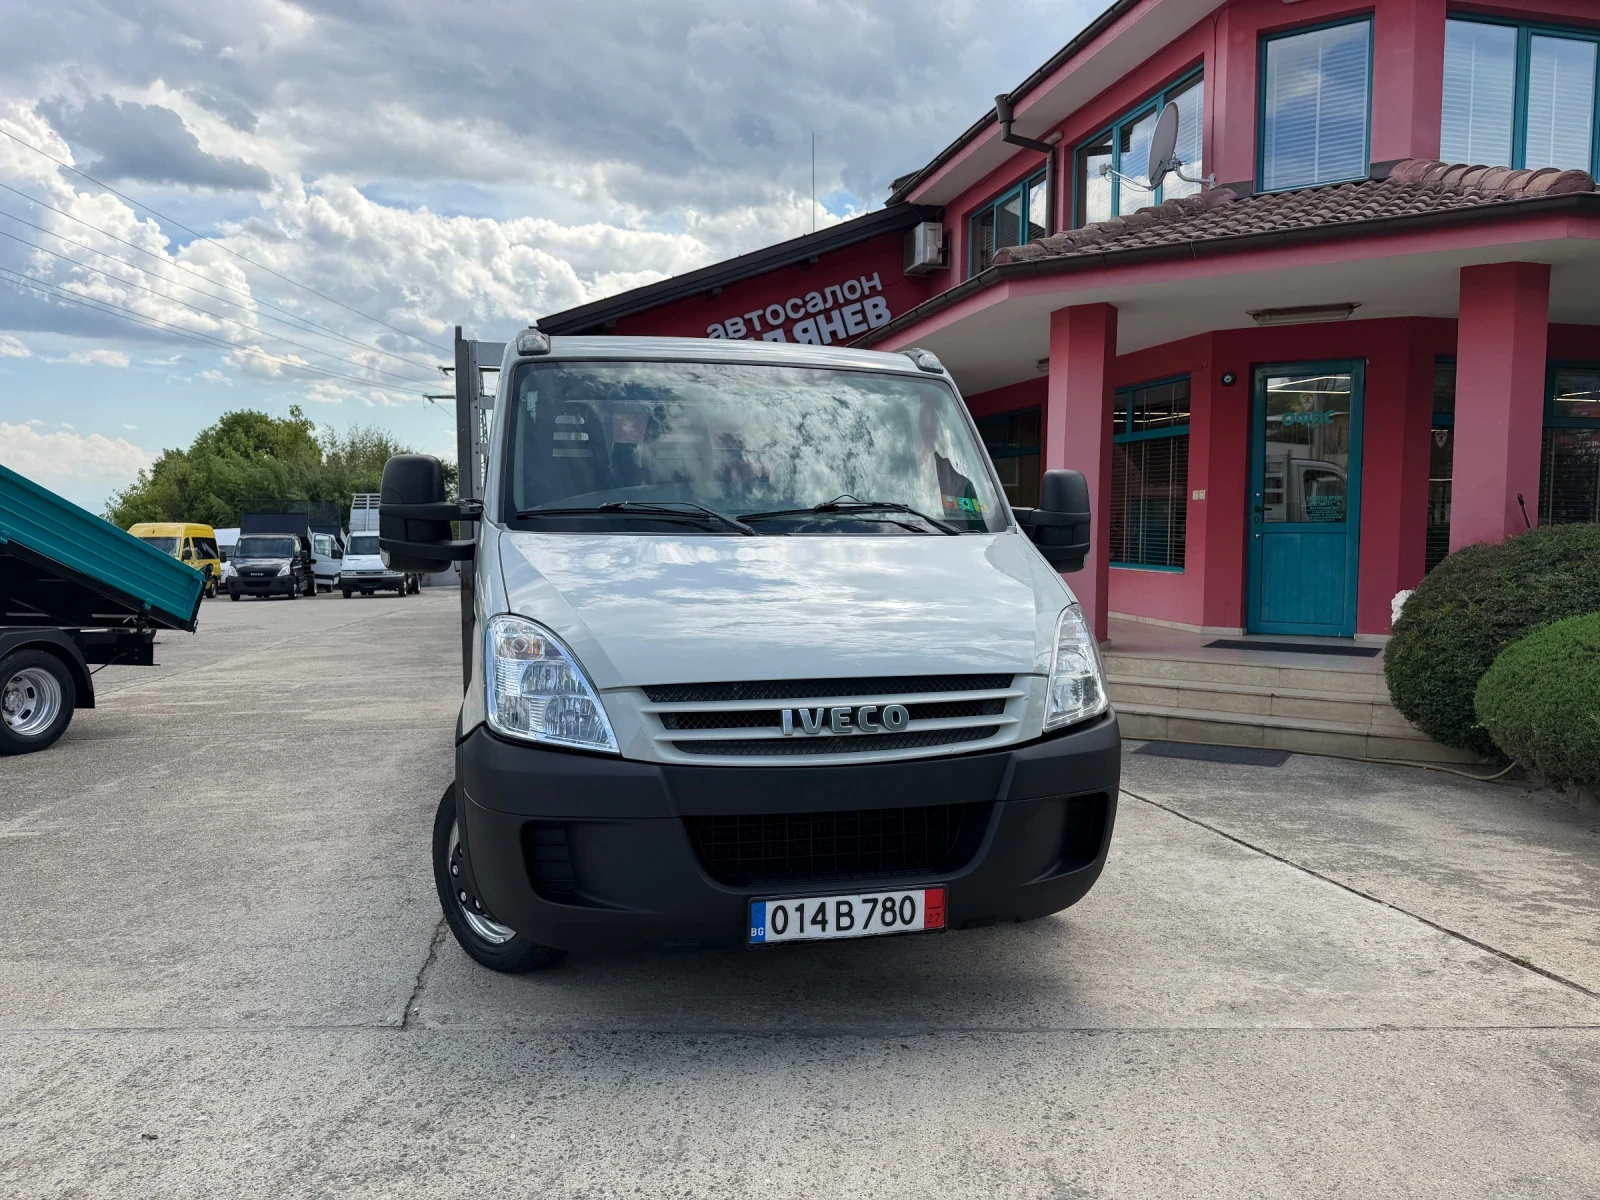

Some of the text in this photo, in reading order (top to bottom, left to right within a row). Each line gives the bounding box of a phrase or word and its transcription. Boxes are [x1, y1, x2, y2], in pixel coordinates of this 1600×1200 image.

[706, 271, 883, 340] автосалон
[792, 295, 892, 345] ЯНЕВ
[1282, 409, 1335, 427] ОФИС
[781, 704, 910, 736] IVECO
[750, 926, 765, 937] BG
[771, 895, 916, 935] 014B780
